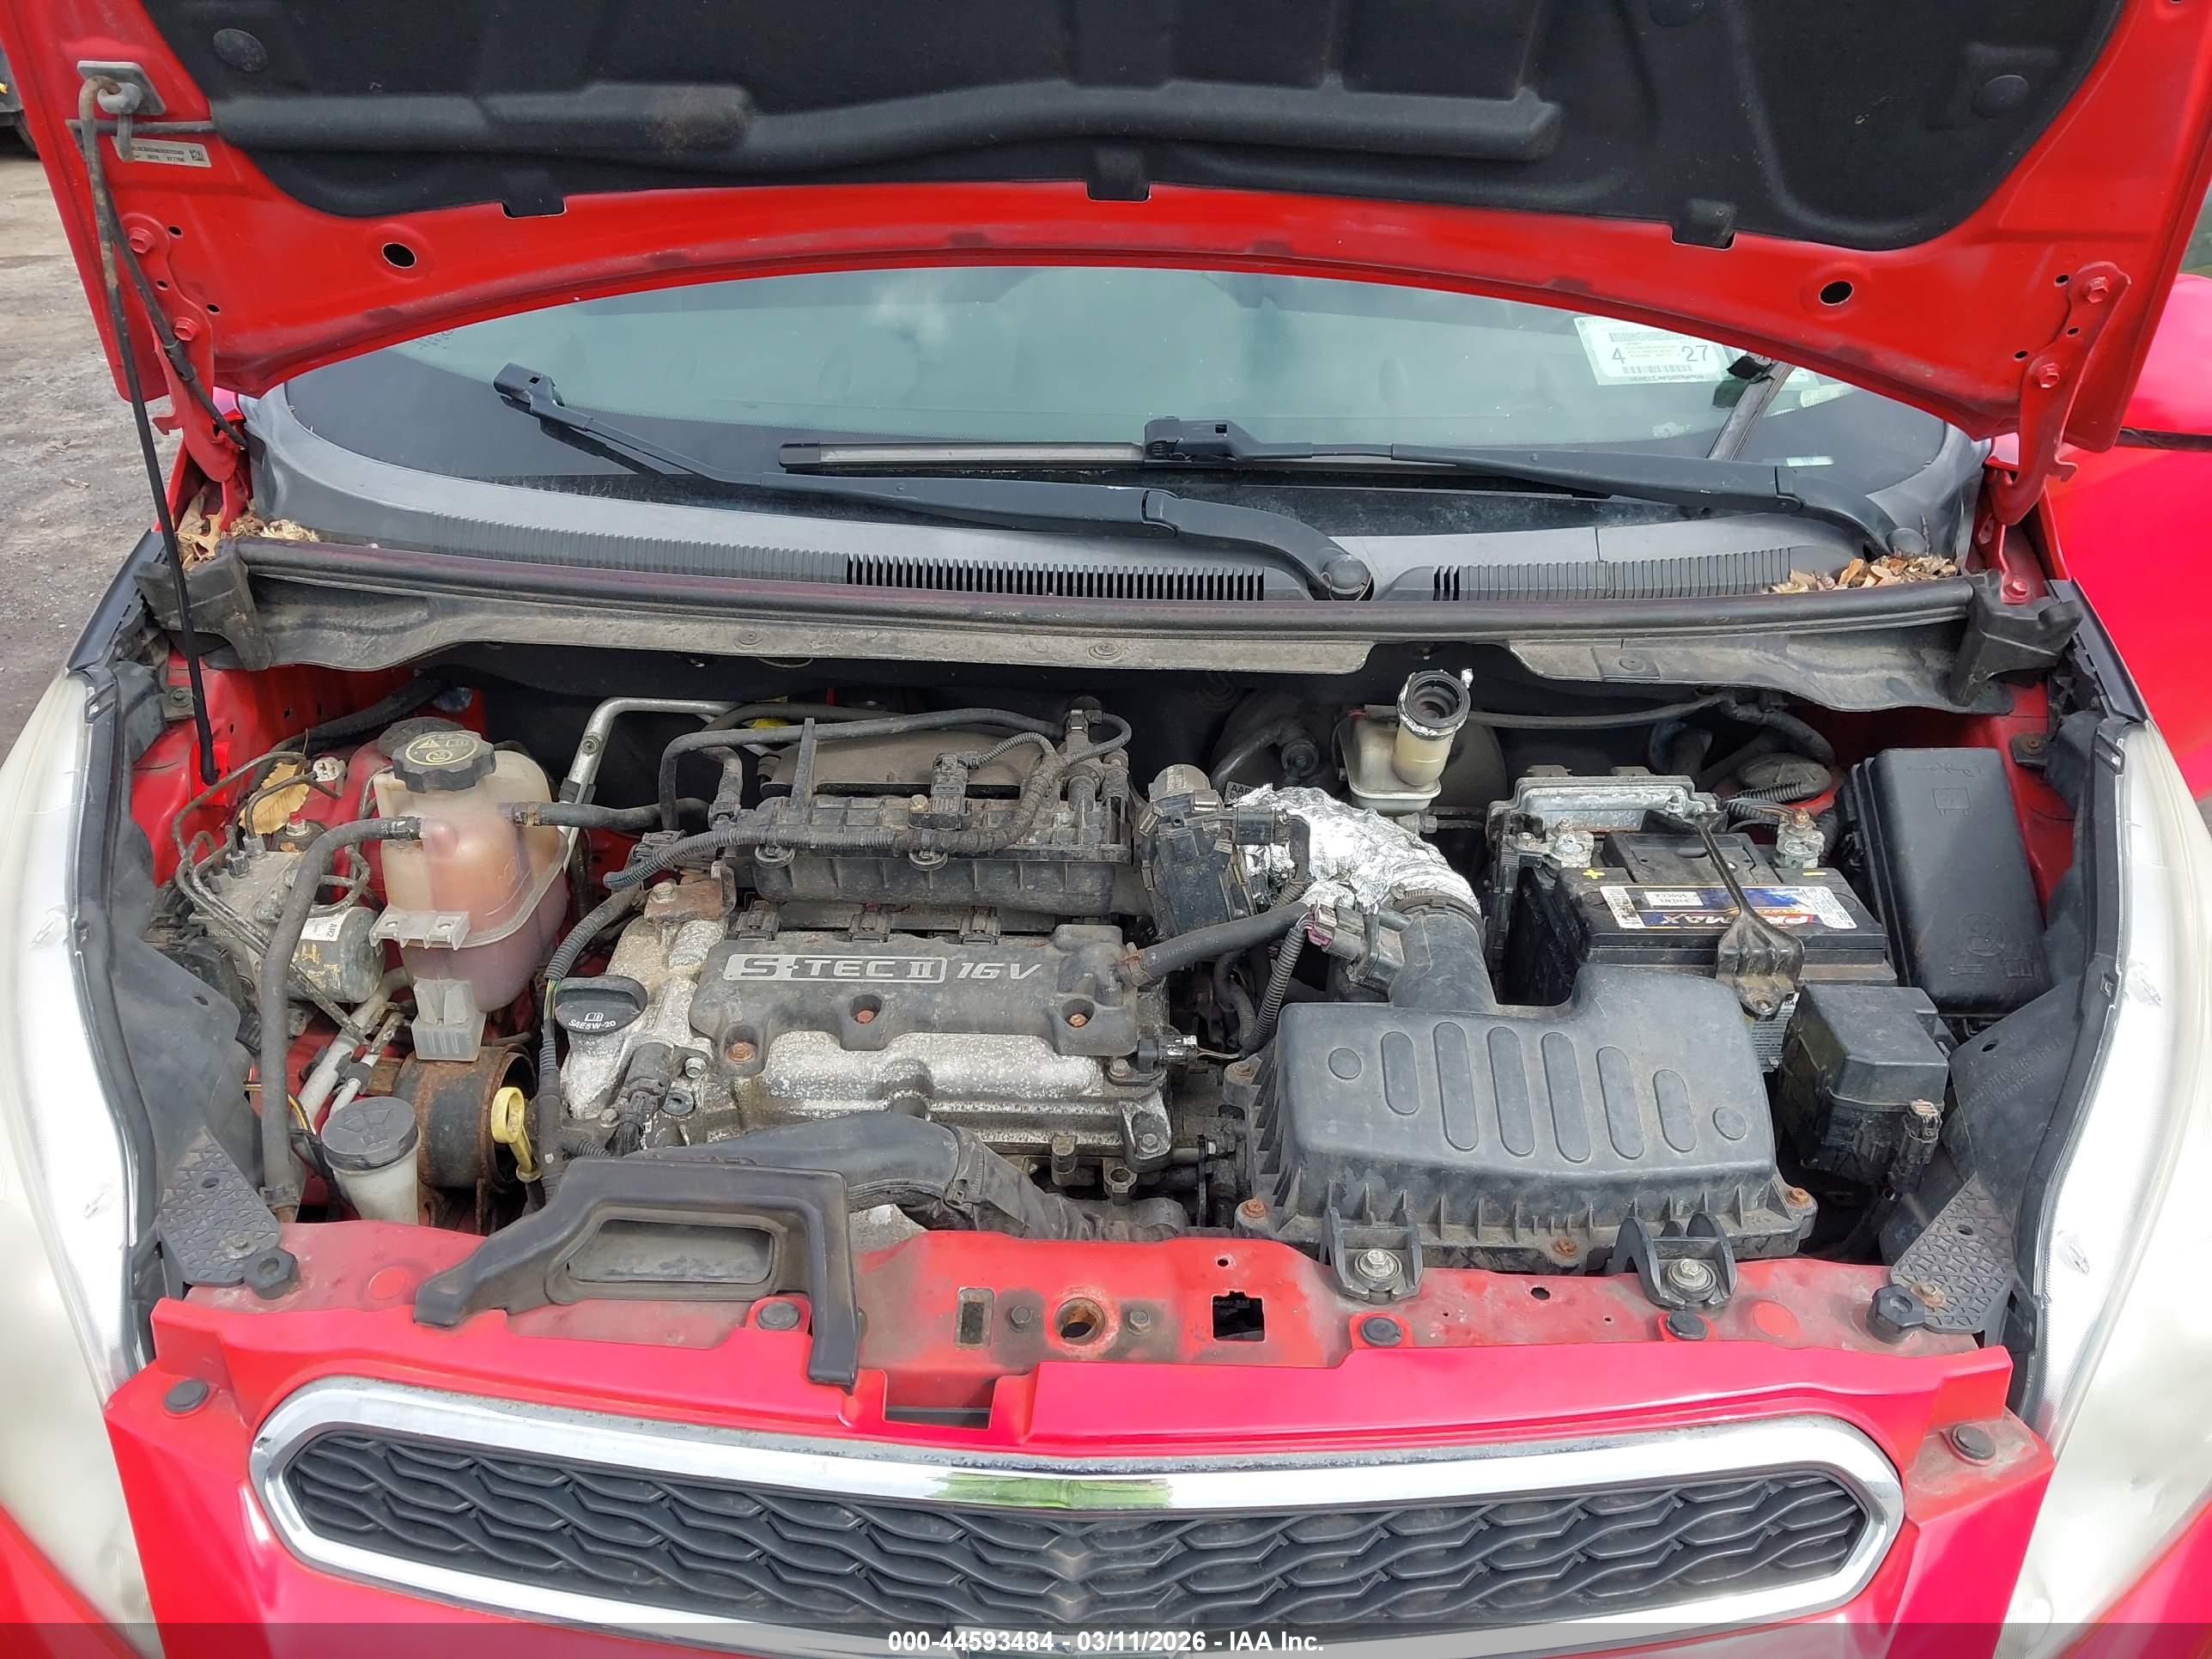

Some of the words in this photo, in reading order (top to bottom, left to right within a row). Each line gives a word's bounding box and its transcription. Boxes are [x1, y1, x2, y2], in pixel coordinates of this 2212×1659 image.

[1611, 347, 1626, 364] 4
[1681, 344, 1709, 362] 27
[1660, 913, 1809, 925] PRMAX
[325, 923, 337, 938] AR2
[740, 957, 896, 978] S-TEC
[907, 960, 935, 980] II
[957, 962, 1042, 981] 16V
